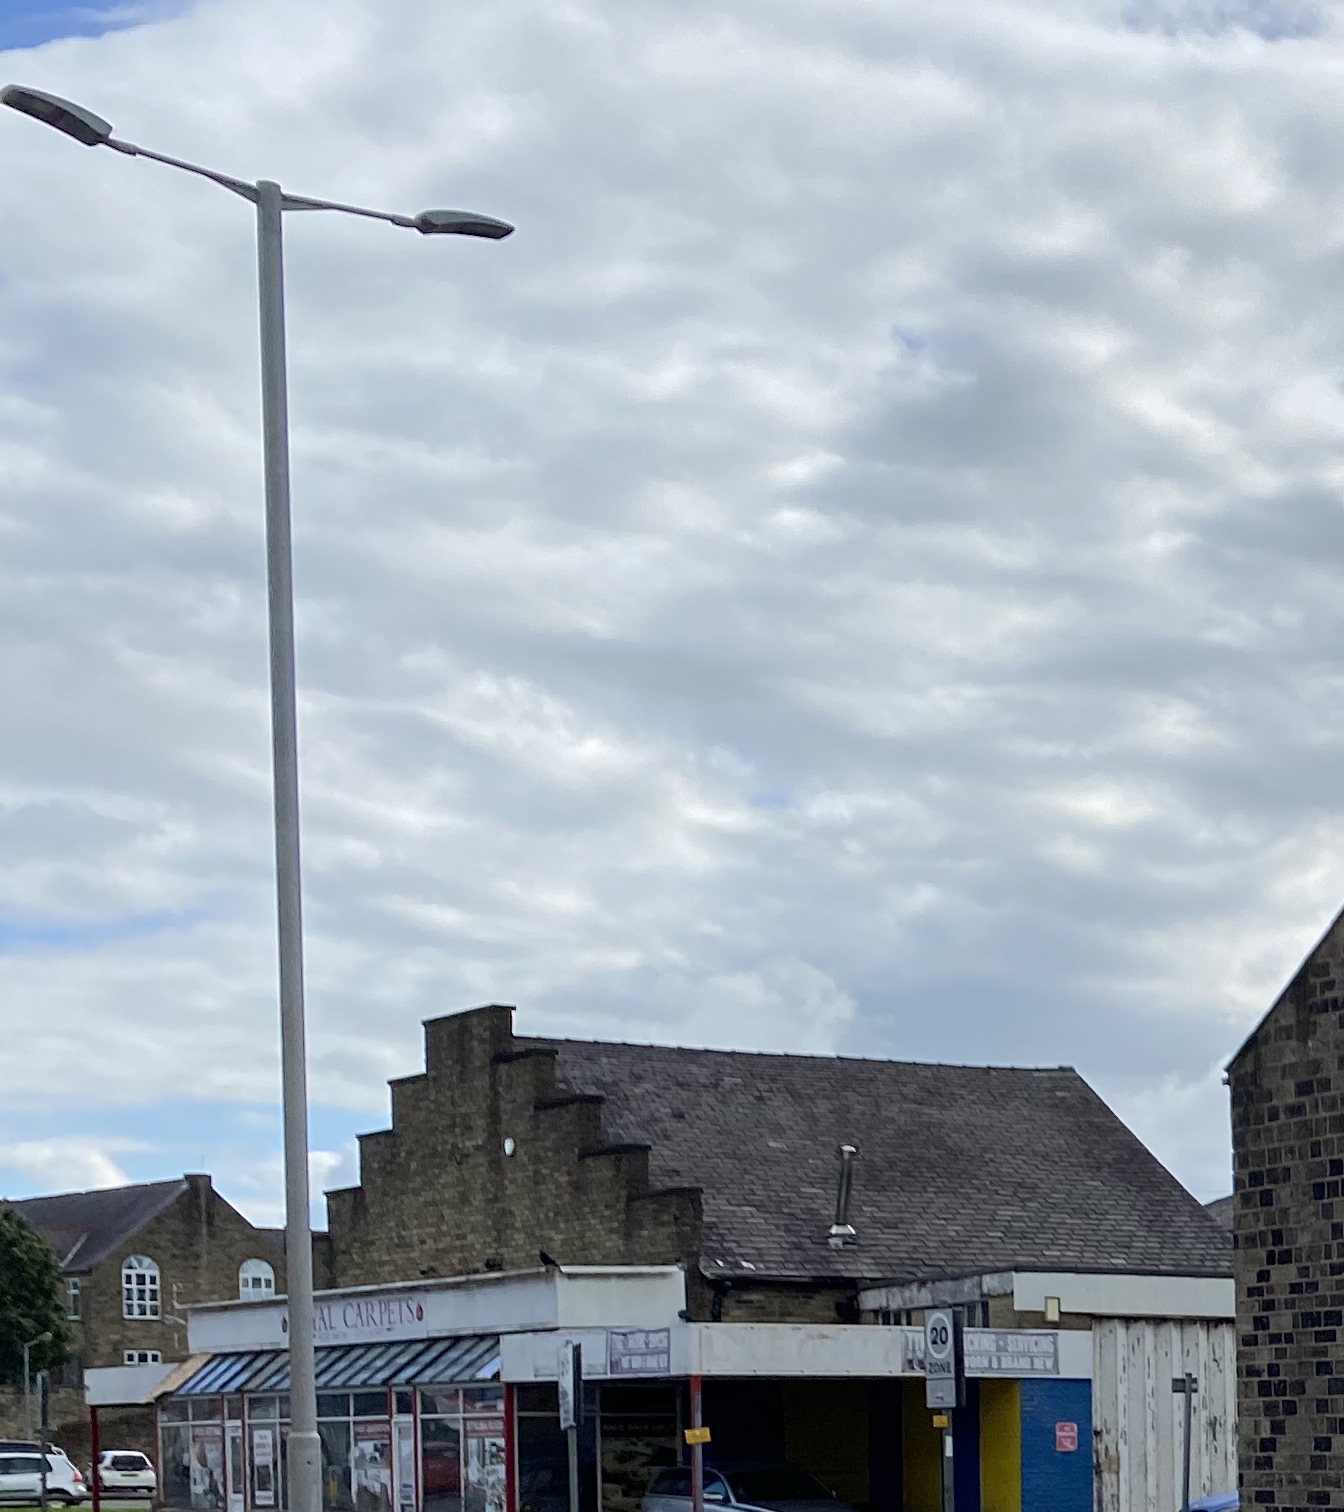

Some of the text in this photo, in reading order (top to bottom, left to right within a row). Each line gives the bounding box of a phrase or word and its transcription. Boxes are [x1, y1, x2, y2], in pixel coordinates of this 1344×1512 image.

[343, 1296, 415, 1329] CARPETS
[930, 1326, 948, 1345] 20
[1007, 1335, 1053, 1352] SERVICING
[928, 1361, 952, 1375] ZONE
